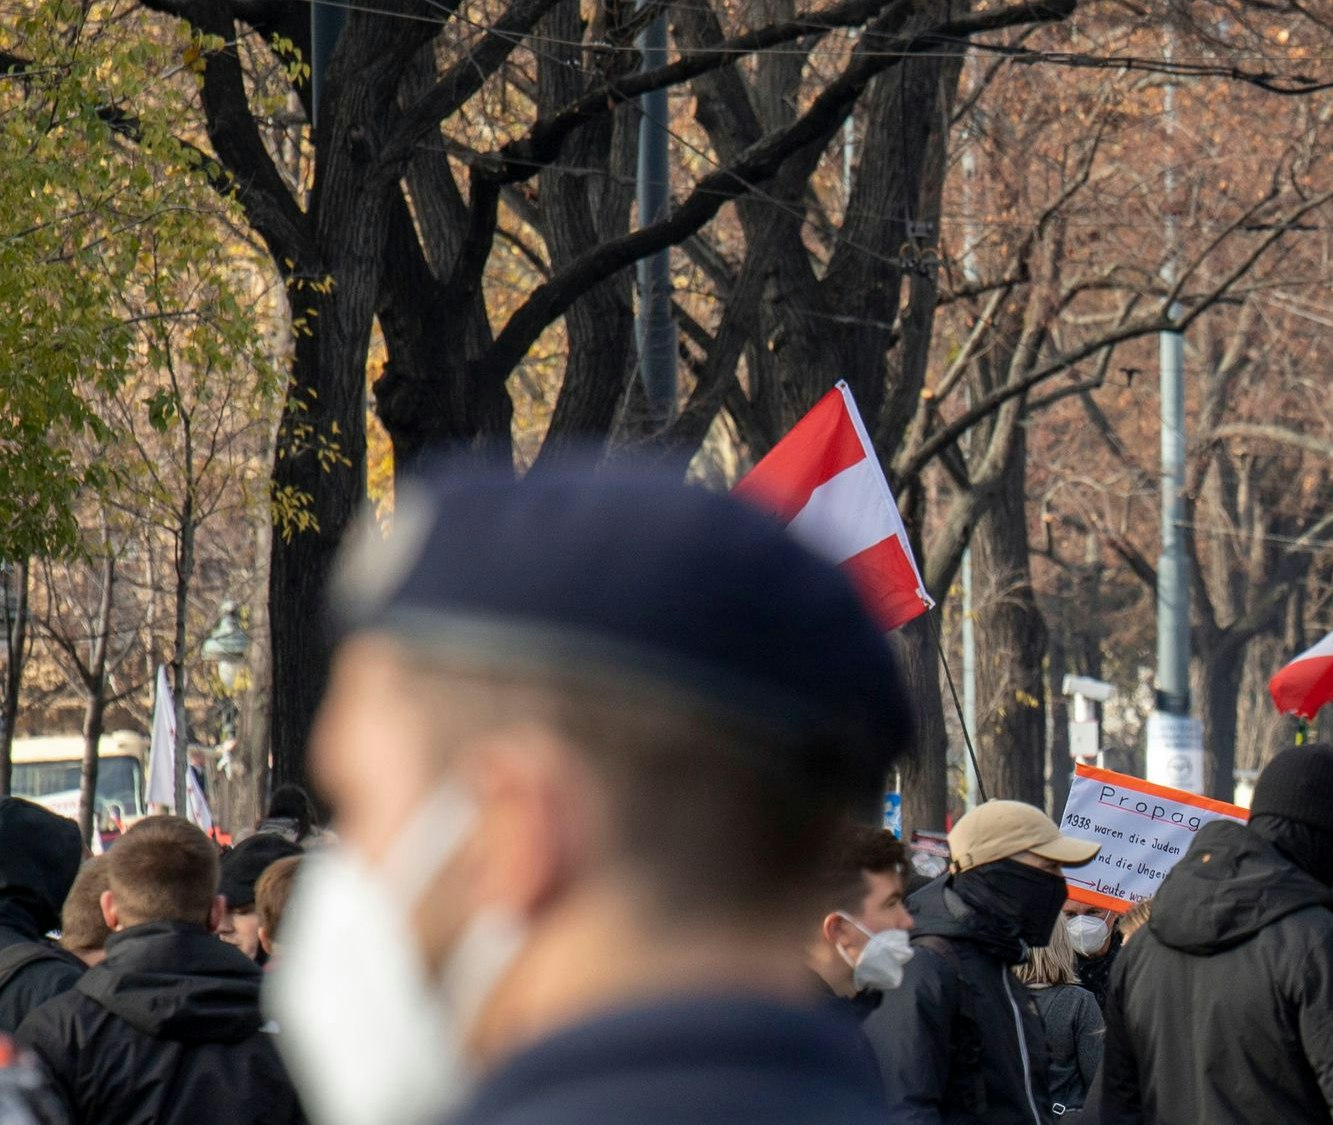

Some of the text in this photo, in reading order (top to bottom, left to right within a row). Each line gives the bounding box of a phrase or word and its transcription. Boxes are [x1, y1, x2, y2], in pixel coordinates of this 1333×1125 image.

[1066, 813, 1180, 855] 1938 waren die Juden
[1115, 857, 1133, 871] die
[1137, 862, 1168, 880] Ungei
[1096, 879, 1126, 898] Leute
